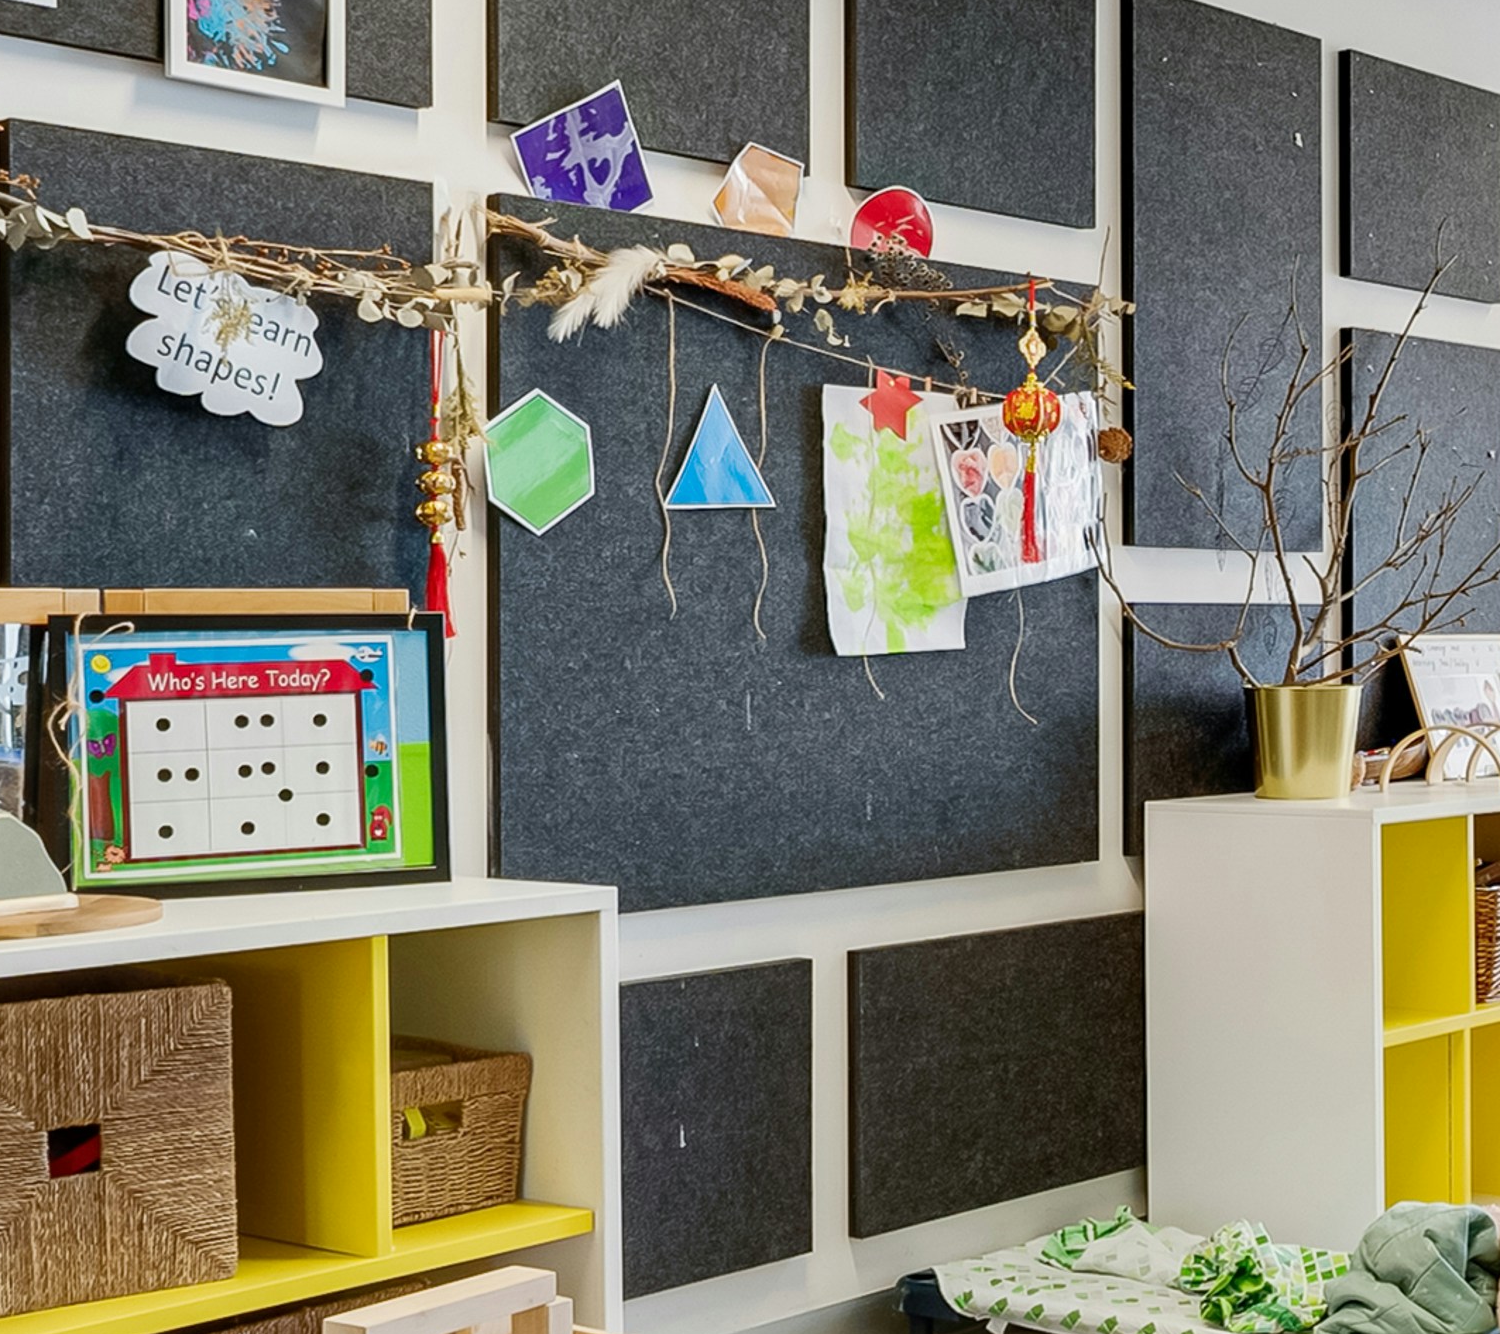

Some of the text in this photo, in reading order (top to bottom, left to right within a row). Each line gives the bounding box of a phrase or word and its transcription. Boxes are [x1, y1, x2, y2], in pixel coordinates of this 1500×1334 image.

[241, 300, 312, 358] earn
[156, 332, 281, 402] shapes!
[147, 668, 331, 692] Who's Here Today?
